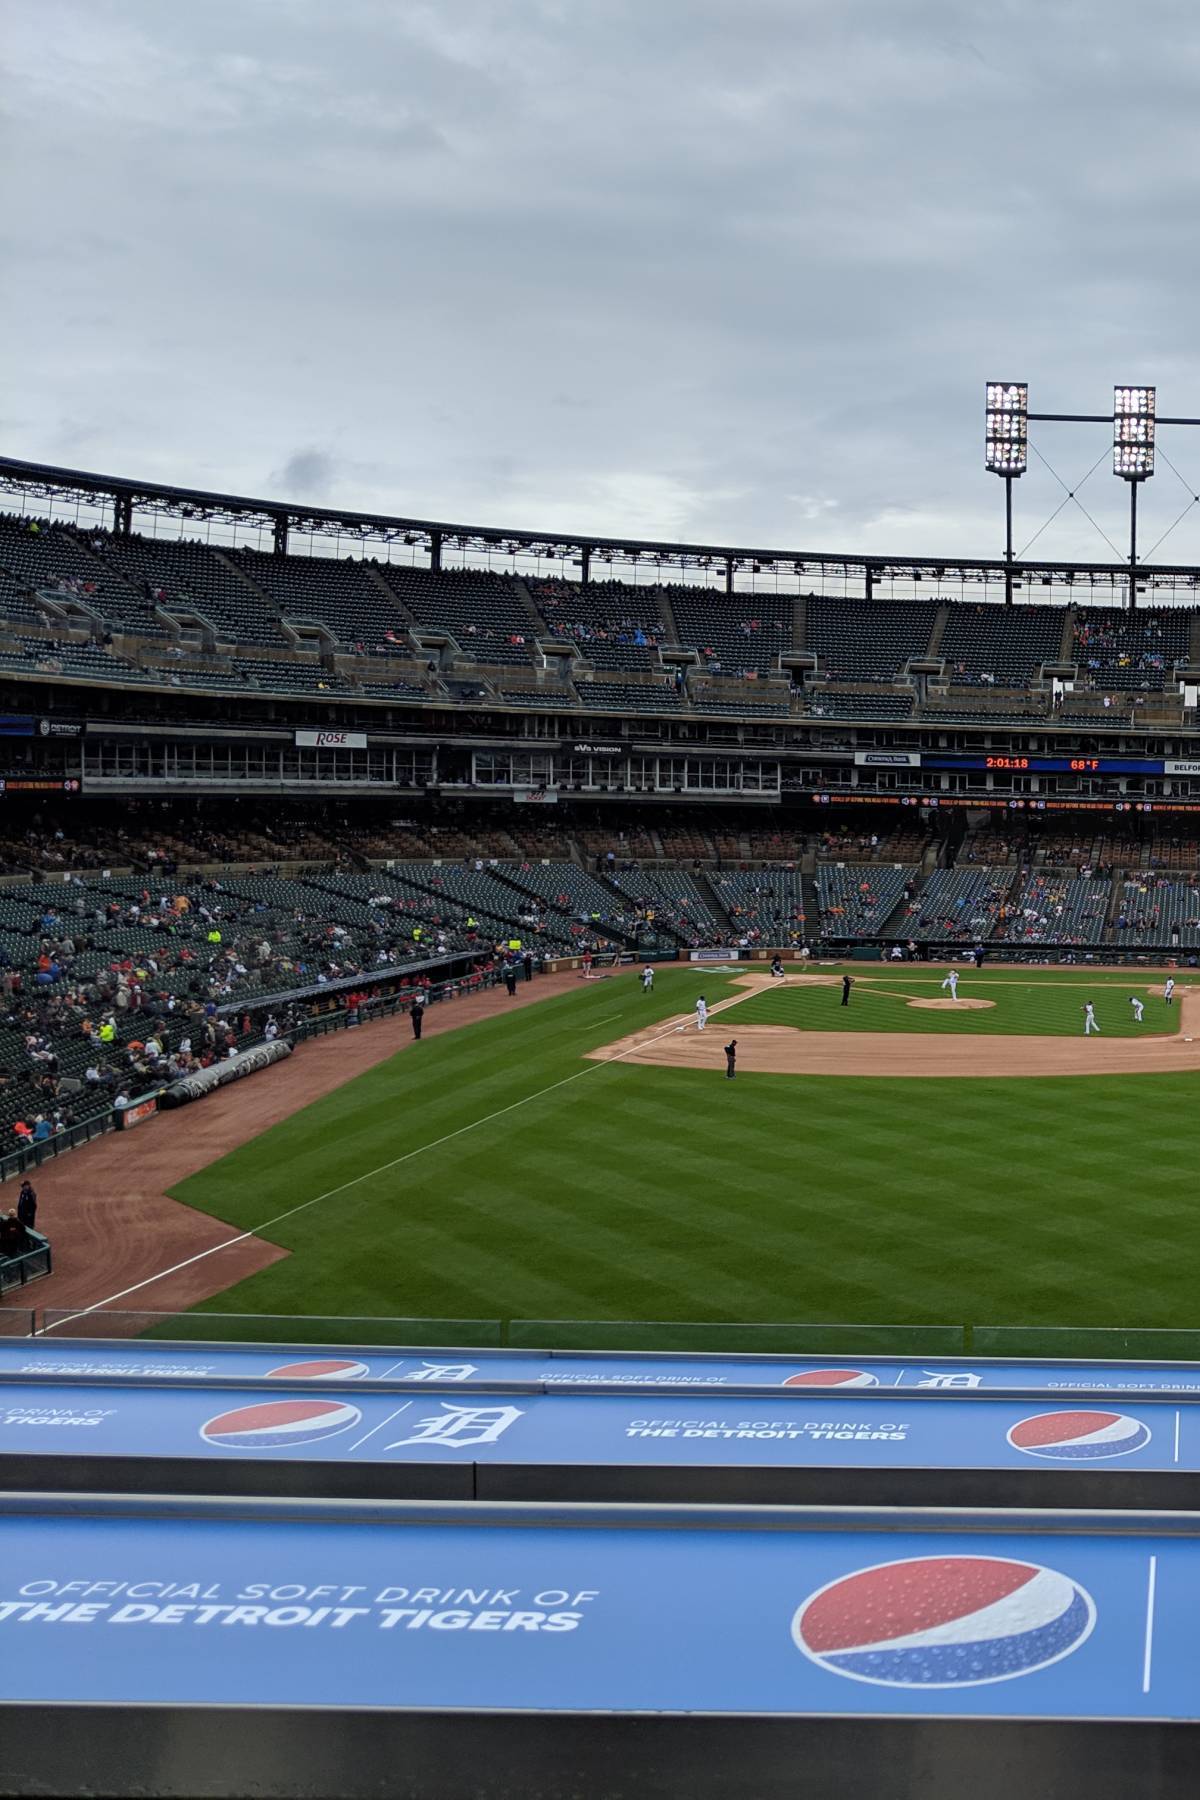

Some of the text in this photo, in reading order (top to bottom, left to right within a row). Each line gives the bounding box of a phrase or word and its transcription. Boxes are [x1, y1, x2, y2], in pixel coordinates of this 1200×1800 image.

[986, 757, 1028, 769] 2:01:18
[3, 1416, 103, 1425] TIGERS
[683, 1430, 803, 1438] DETROIT
[810, 1431, 906, 1440] TIGERS
[20, 1581, 599, 1606] OFFICIAL SOFT DRINK OF
[0, 1602, 582, 1631] THE DETROIT TIGERS
